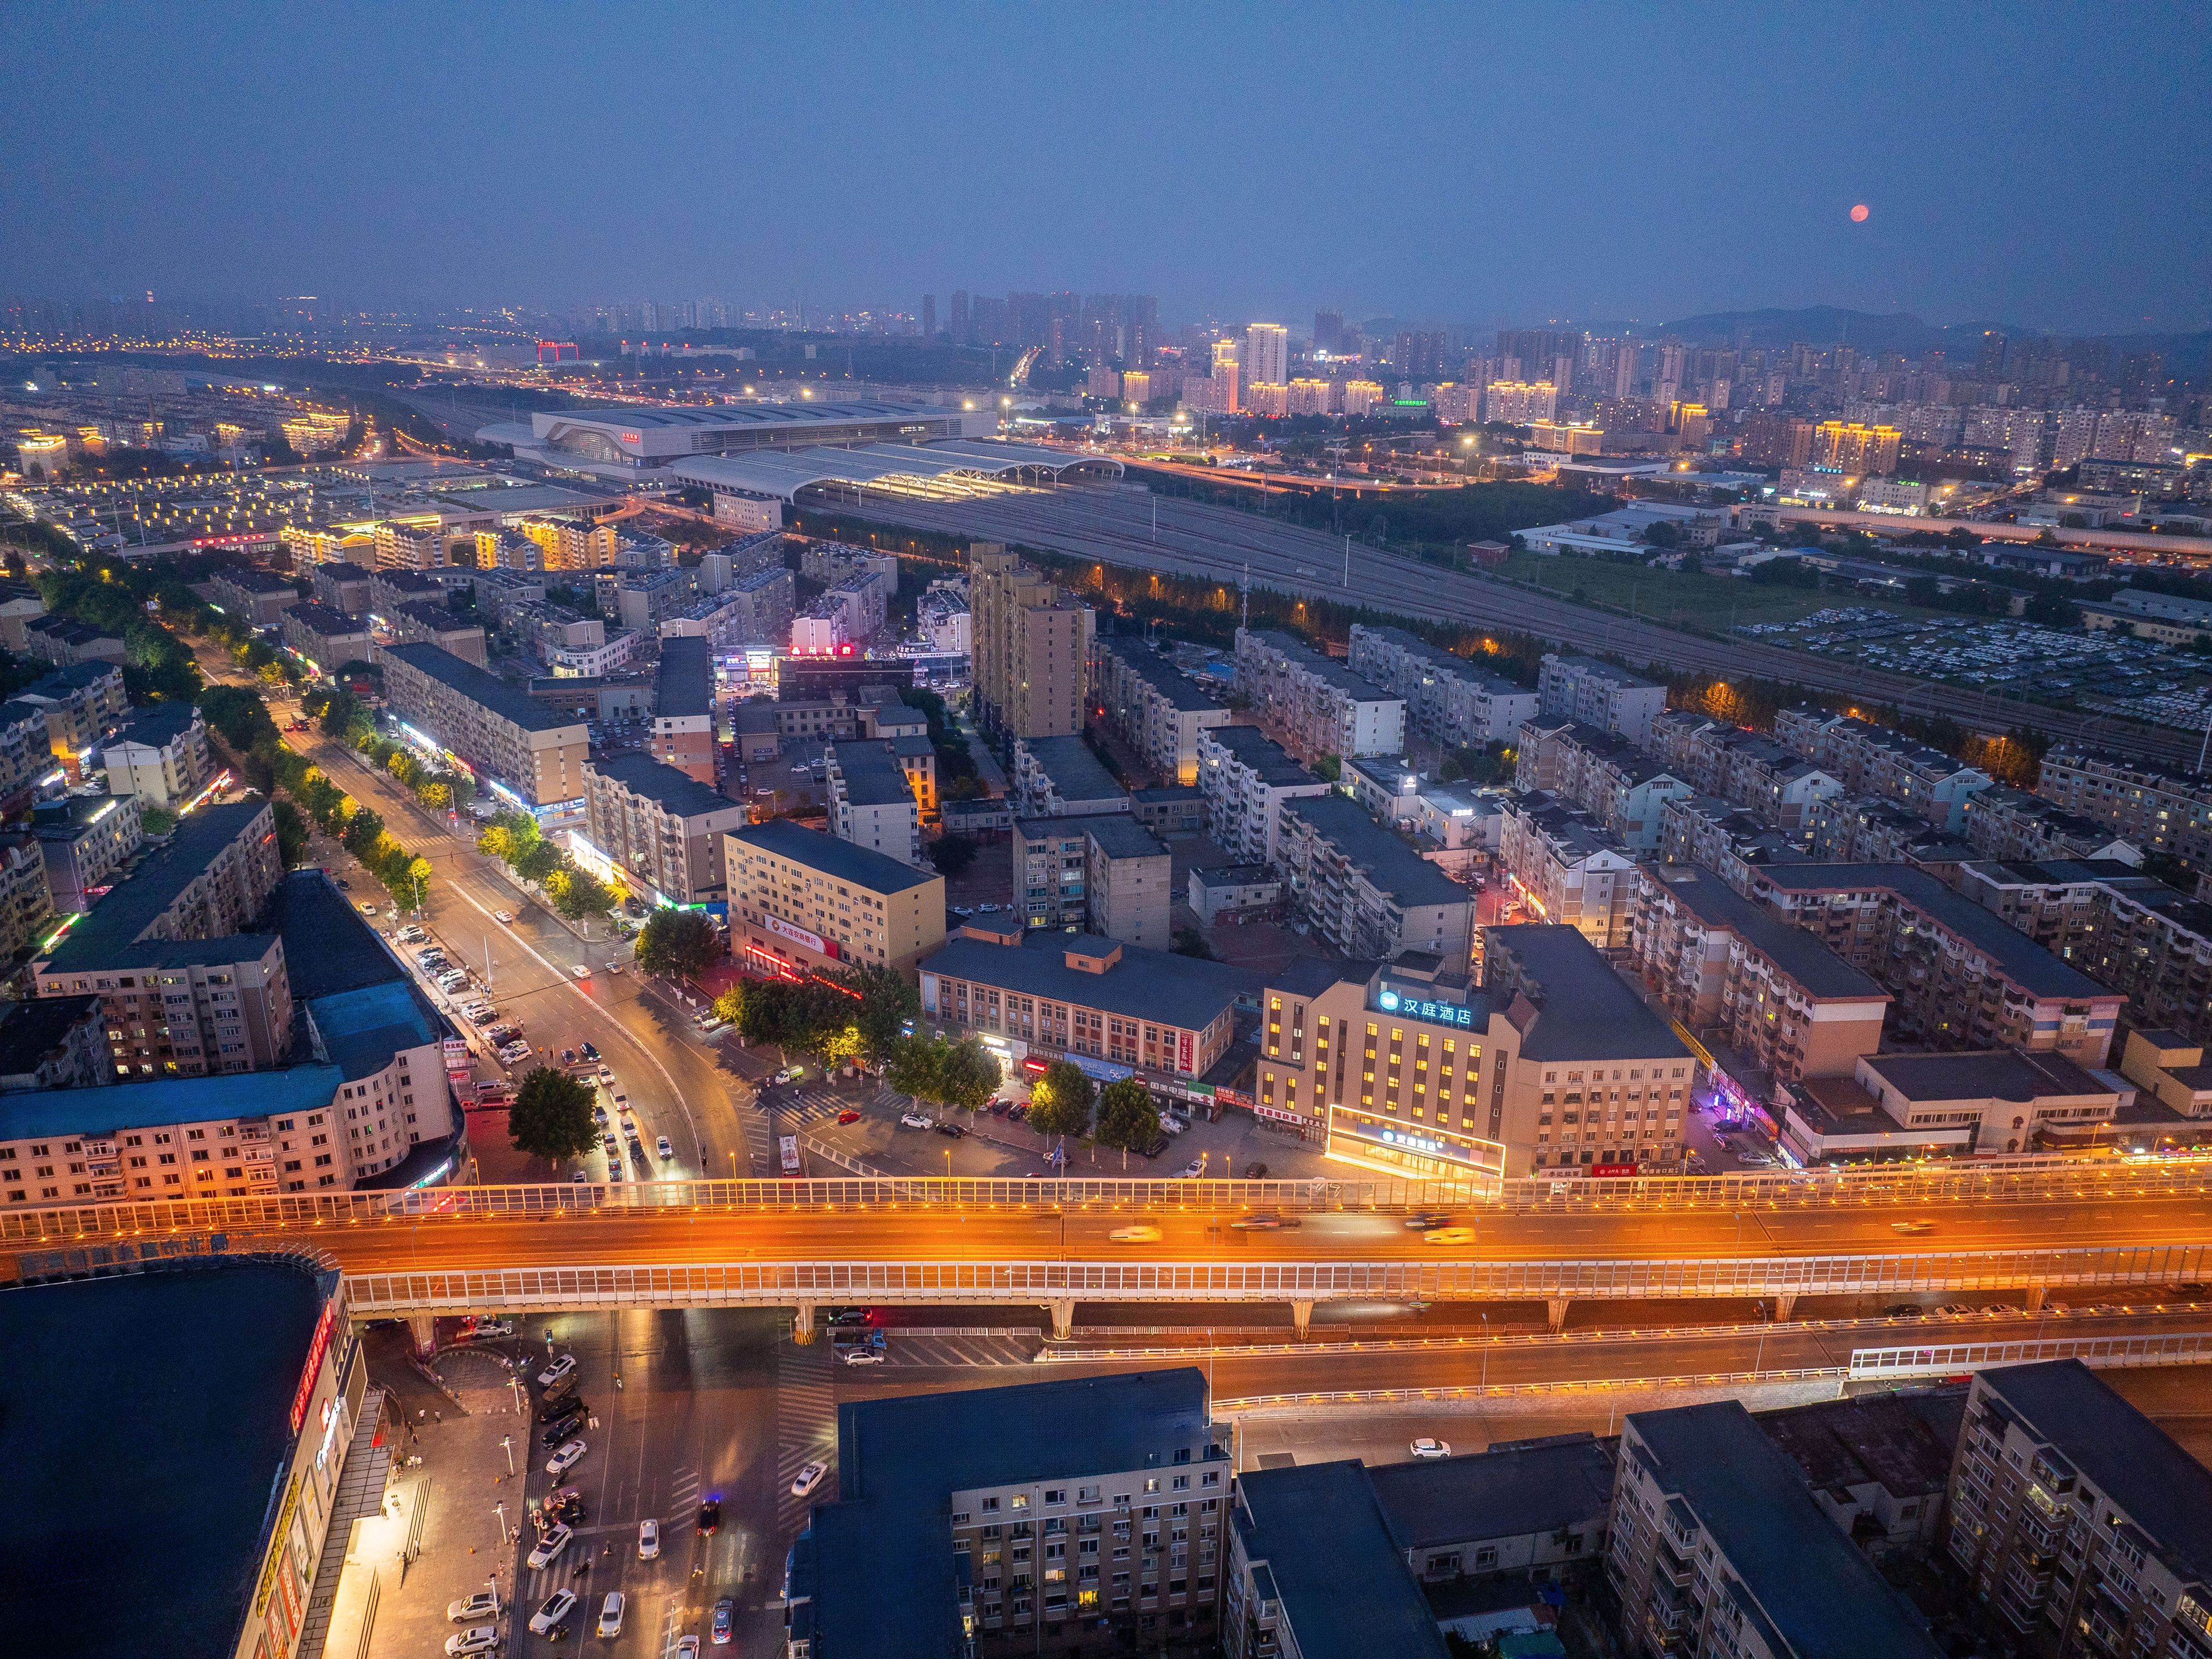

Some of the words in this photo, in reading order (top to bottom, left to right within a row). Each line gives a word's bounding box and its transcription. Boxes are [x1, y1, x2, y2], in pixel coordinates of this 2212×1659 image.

[782, 926, 816, 946] 大连农商银行
[1405, 999, 1471, 1024] 汉庭酒店
